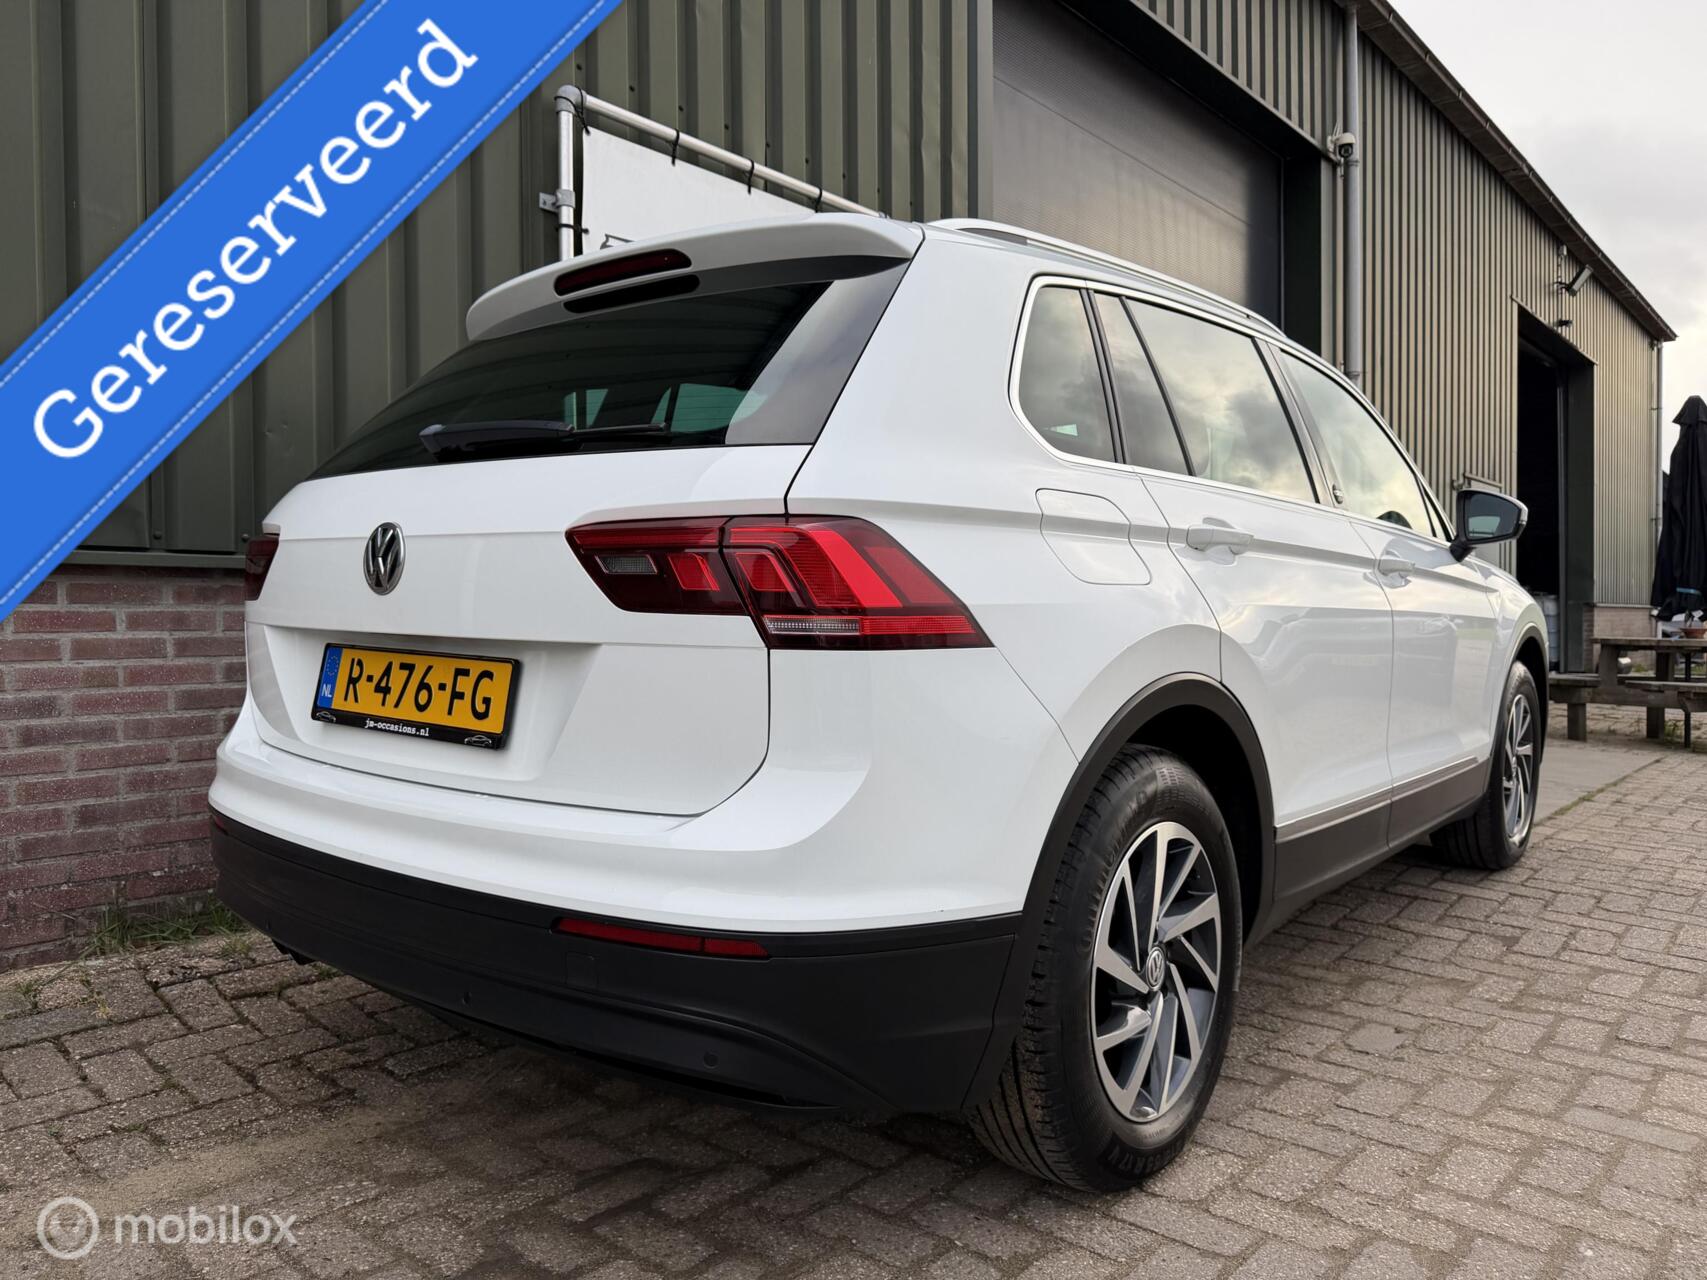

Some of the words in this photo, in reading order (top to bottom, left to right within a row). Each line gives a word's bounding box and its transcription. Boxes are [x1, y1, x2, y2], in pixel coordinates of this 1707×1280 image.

[321, 683, 333, 698] NL
[343, 657, 495, 721] R-476-FG
[364, 718, 430, 737] jm-occasions.nl
